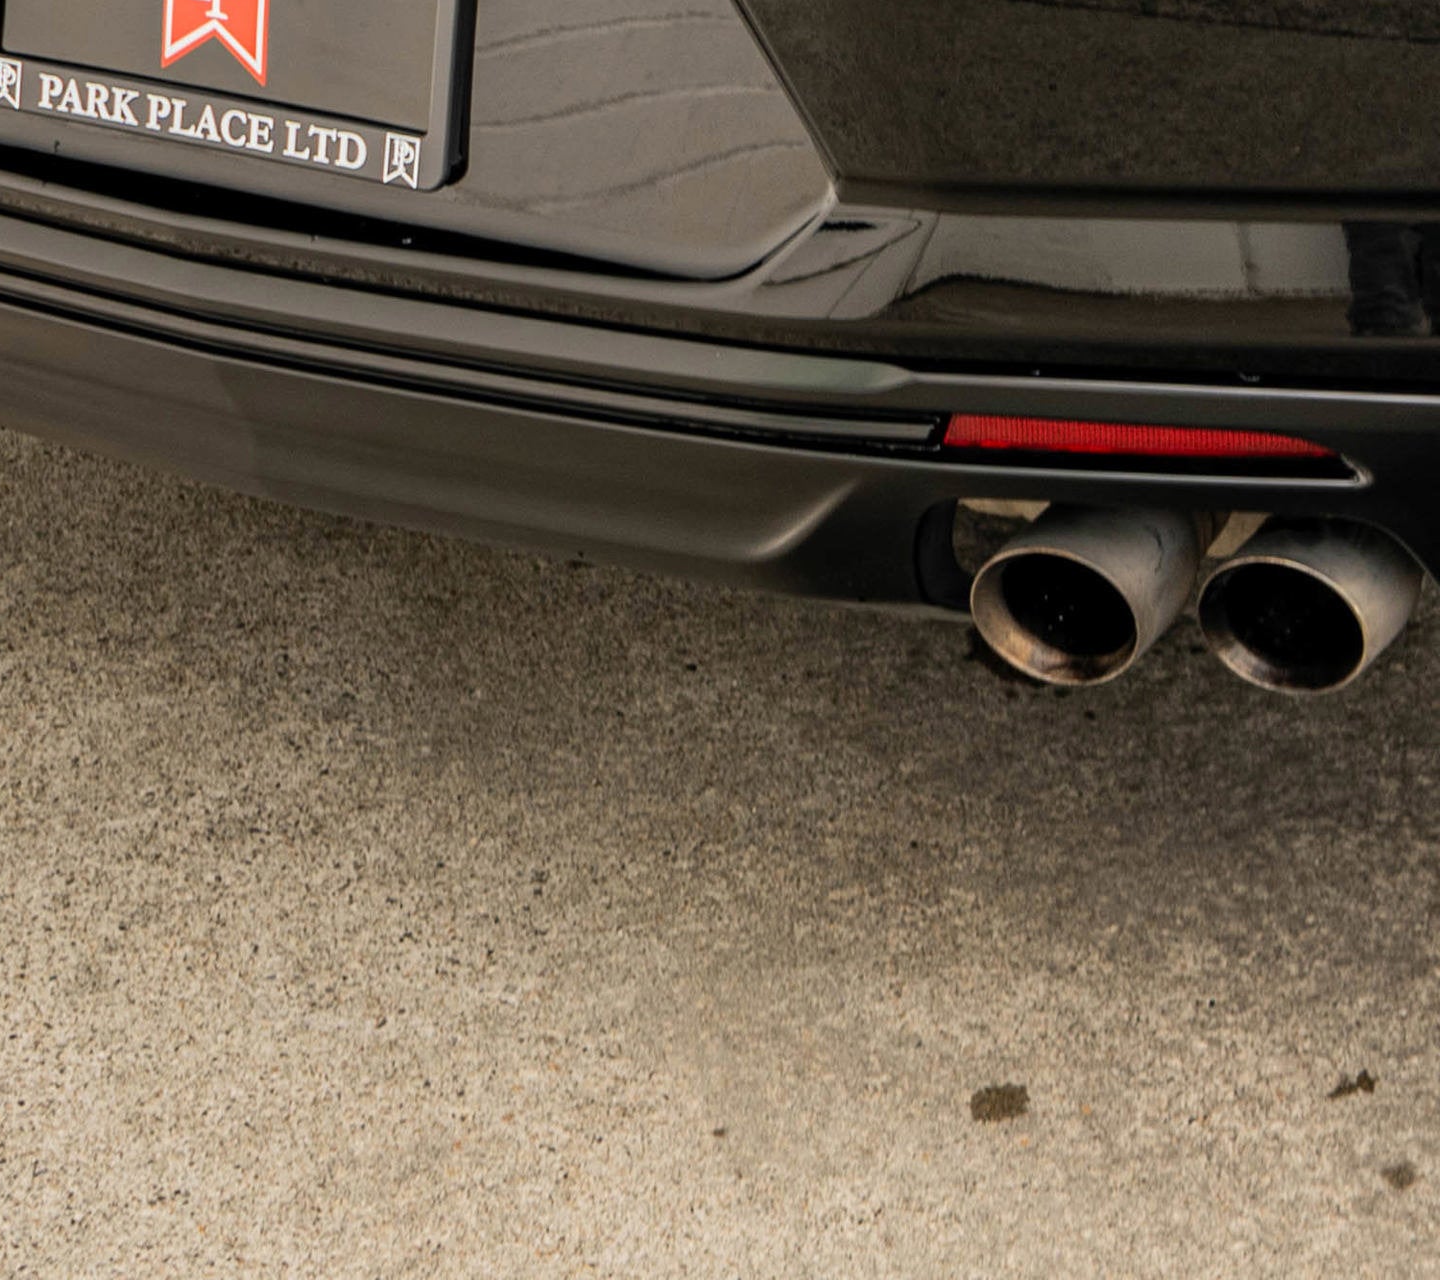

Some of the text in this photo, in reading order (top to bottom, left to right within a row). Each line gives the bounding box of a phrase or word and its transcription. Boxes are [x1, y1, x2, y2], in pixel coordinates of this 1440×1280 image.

[38, 71, 368, 171] PARK PLACE LTD
